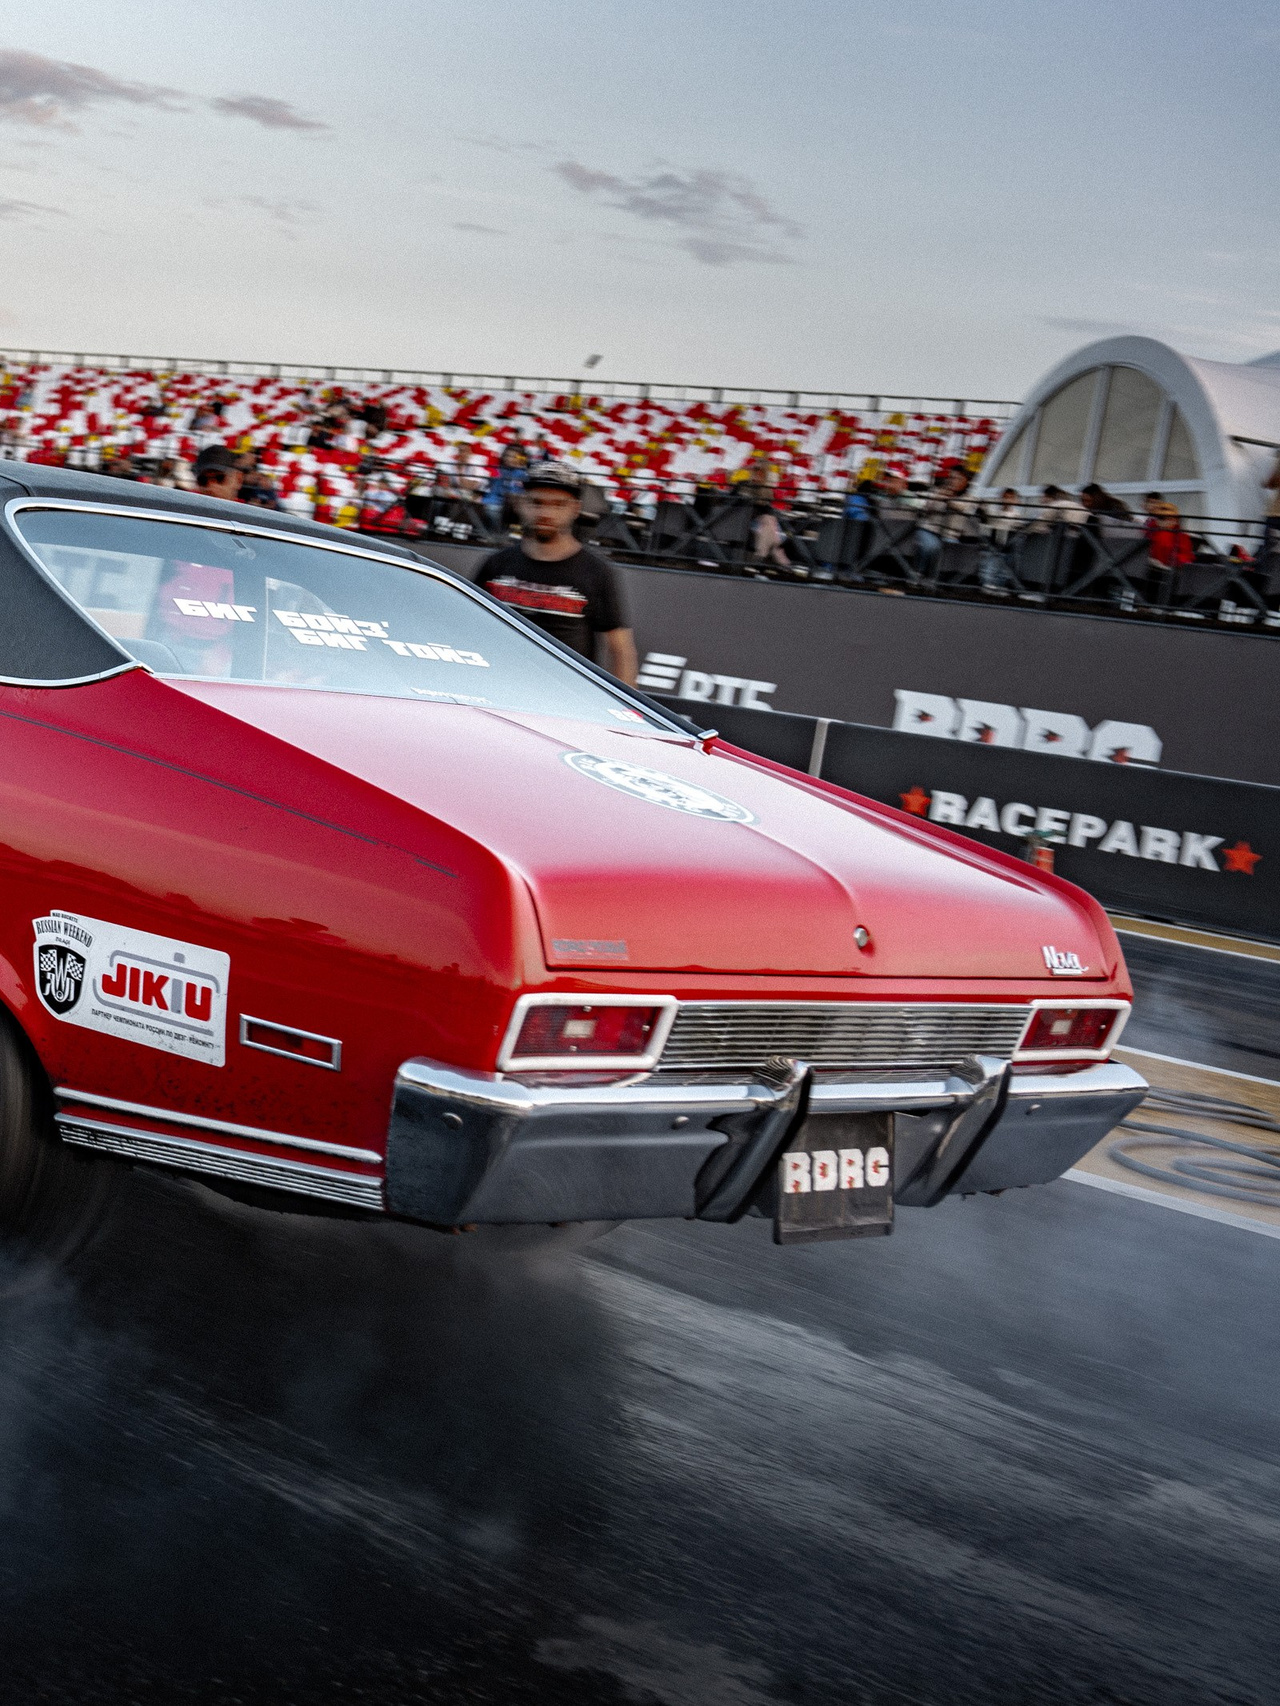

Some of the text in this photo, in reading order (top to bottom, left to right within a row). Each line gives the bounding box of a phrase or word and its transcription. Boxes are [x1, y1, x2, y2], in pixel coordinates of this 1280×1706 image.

[173, 598, 257, 622] БИГ
[288, 628, 491, 668] БИГ ТОЙЗ
[928, 789, 1225, 872] RACEPARK
[35, 919, 94, 949] RUSSIAN WEEKEND
[1042, 945, 1089, 973] Nova
[91, 1008, 112, 1021] ПАРТНЕР
